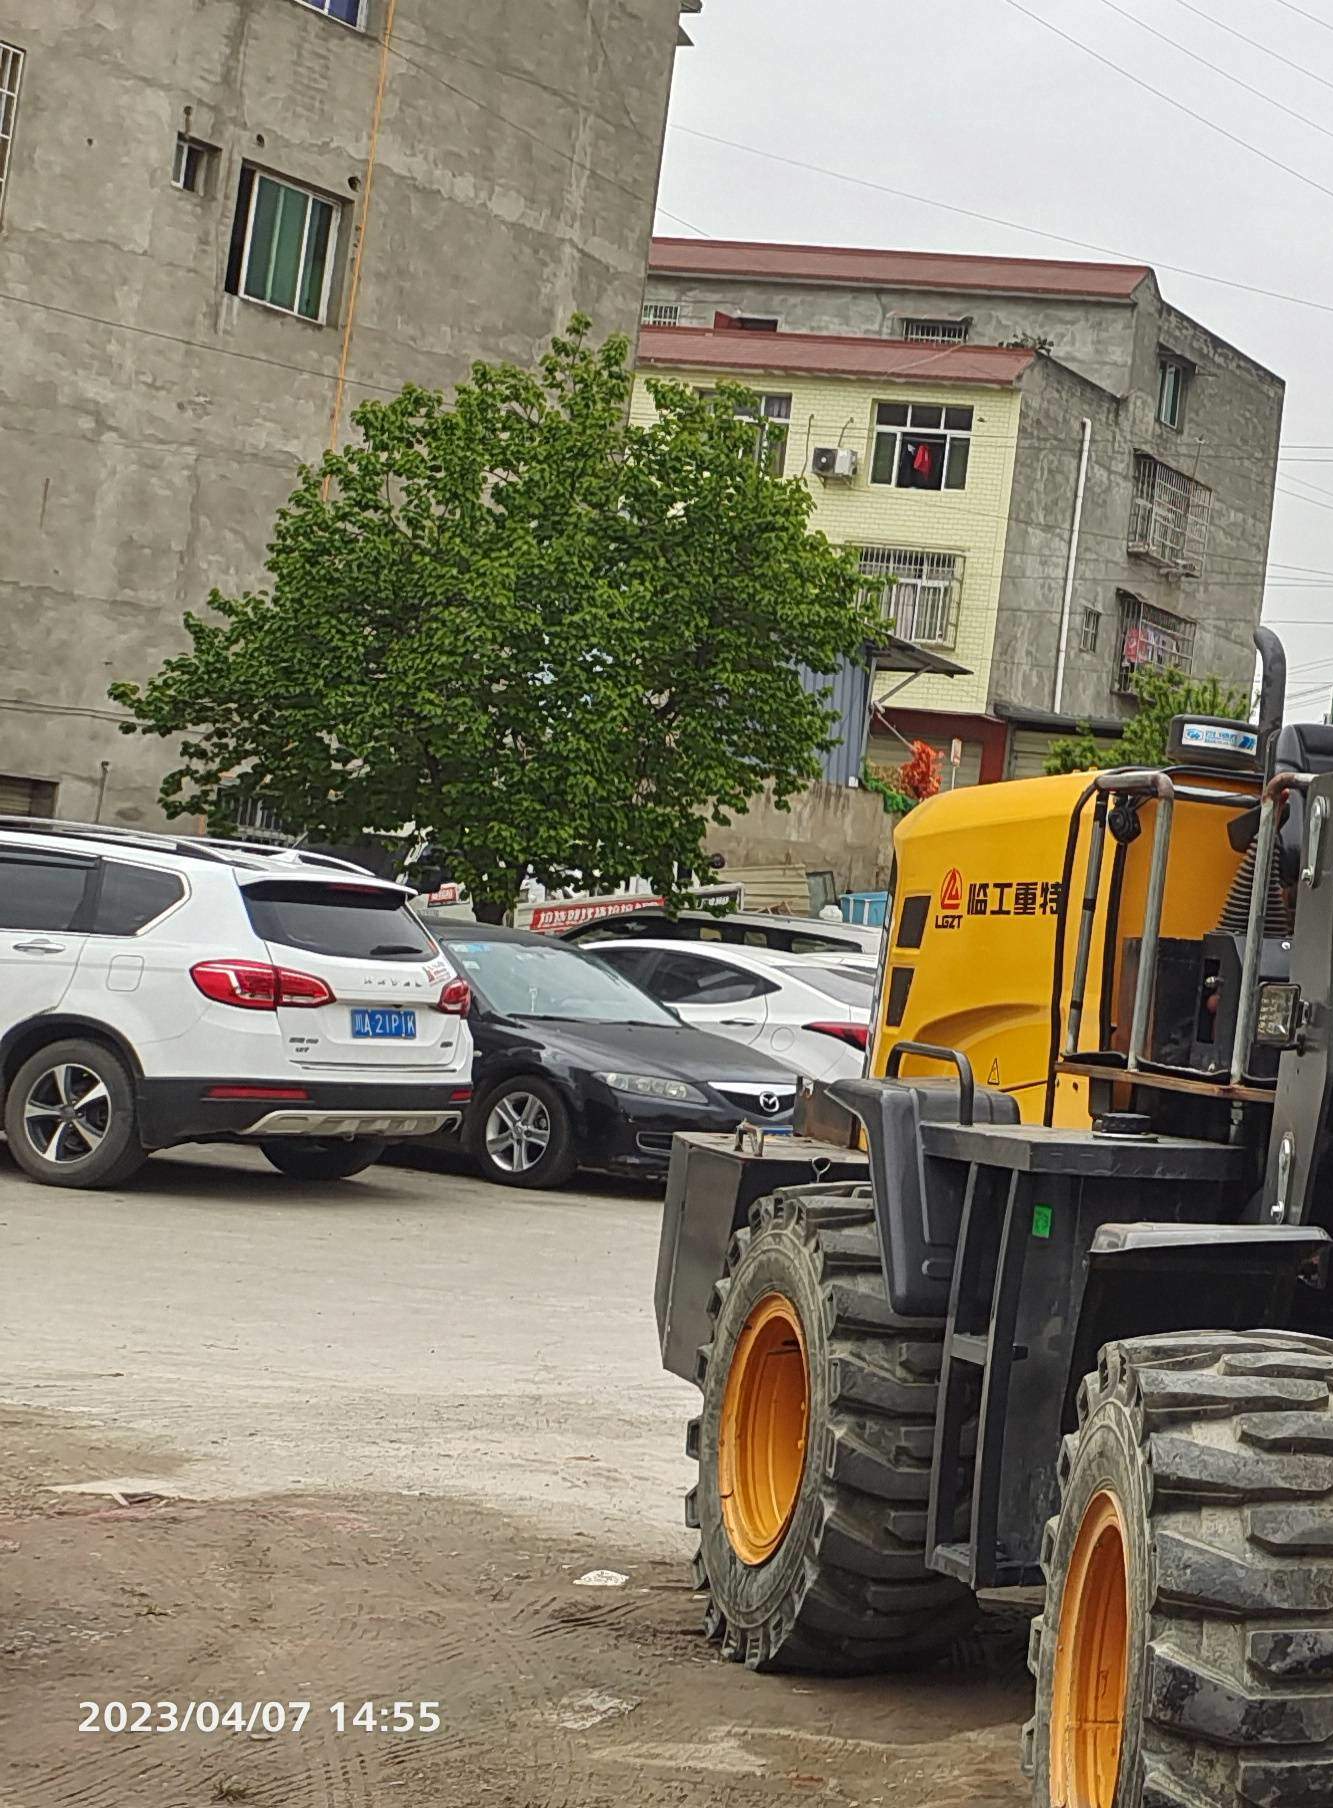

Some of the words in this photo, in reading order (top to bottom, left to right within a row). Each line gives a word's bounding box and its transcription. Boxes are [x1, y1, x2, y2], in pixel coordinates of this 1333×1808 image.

[966, 880, 1063, 916] 临工重特
[934, 914, 963, 930] LGZT
